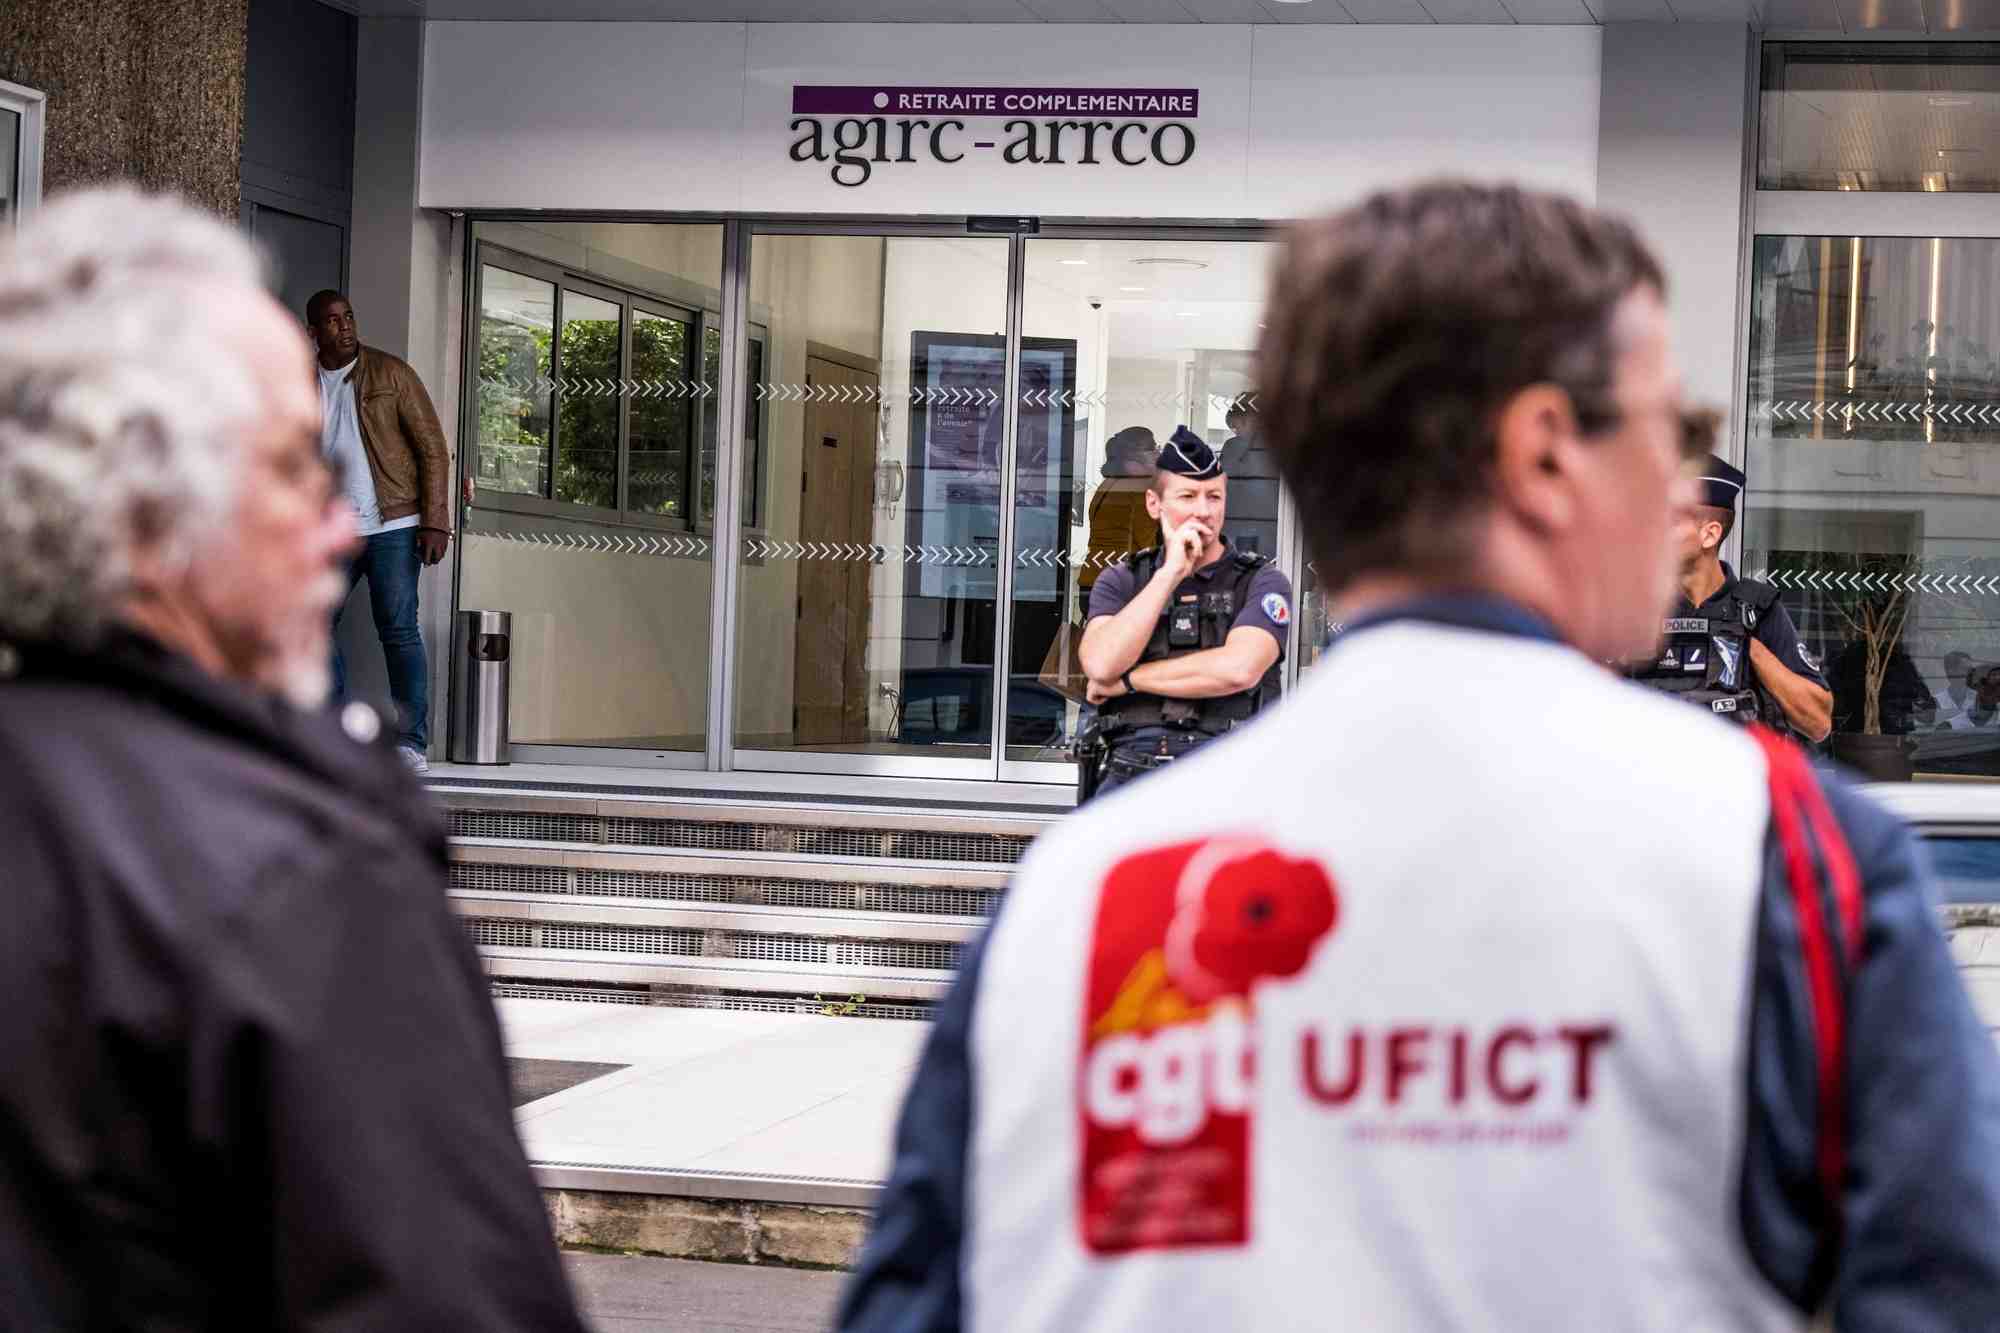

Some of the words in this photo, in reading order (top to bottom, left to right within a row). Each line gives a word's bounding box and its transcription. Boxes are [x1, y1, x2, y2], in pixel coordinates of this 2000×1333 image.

[898, 93, 996, 110] RETRAITE
[1003, 94, 1194, 112] COMPLEMENTAIRE
[789, 115, 1196, 187] agirc-arrco
[1664, 620, 1705, 631] POLICE
[1300, 1024, 1616, 1107] UFICT
